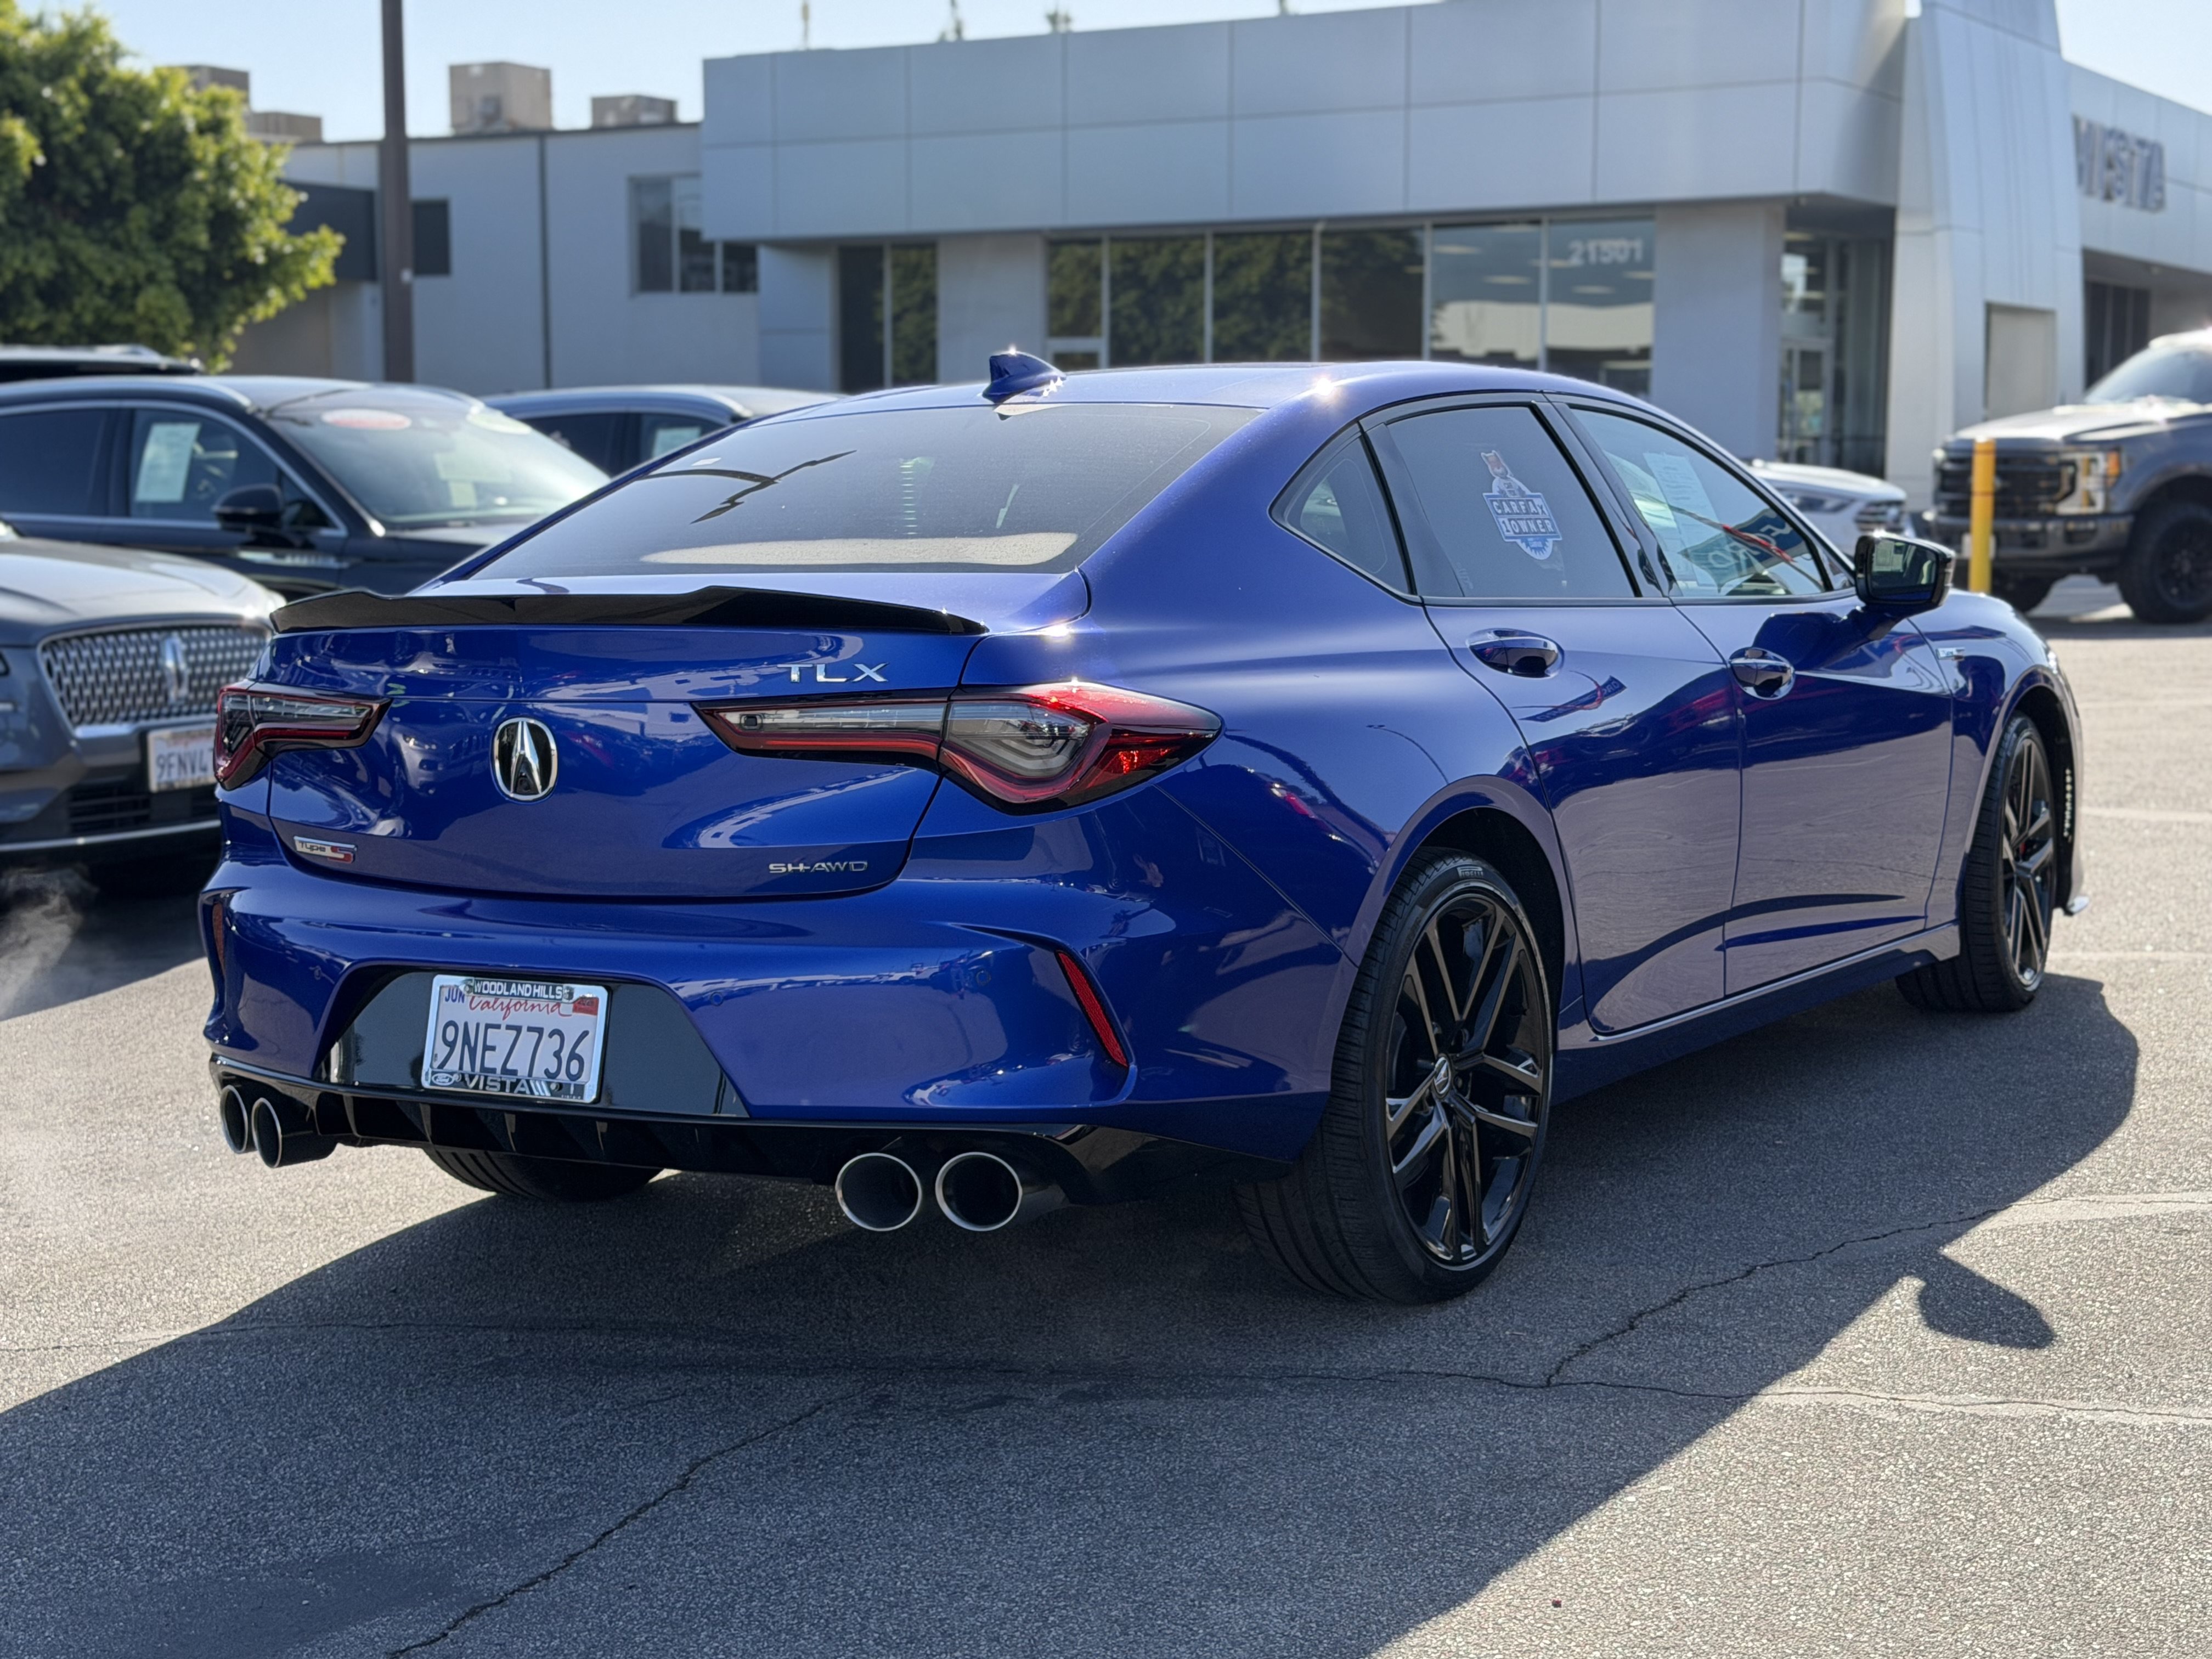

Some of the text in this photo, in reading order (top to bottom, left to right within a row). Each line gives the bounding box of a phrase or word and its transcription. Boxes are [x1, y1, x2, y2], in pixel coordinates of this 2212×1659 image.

[1492, 500, 1548, 515] CARFAX
[1511, 520, 1555, 533] OWNER
[776, 663, 890, 683] TLX
[157, 748, 215, 779] 9FNV4
[300, 842, 353, 864] Type S
[769, 861, 868, 873] SH-AWD
[474, 980, 562, 1000] WOODLAND HILLS
[439, 1020, 590, 1081] 9NEZ736
[465, 1074, 531, 1095] VISTA
